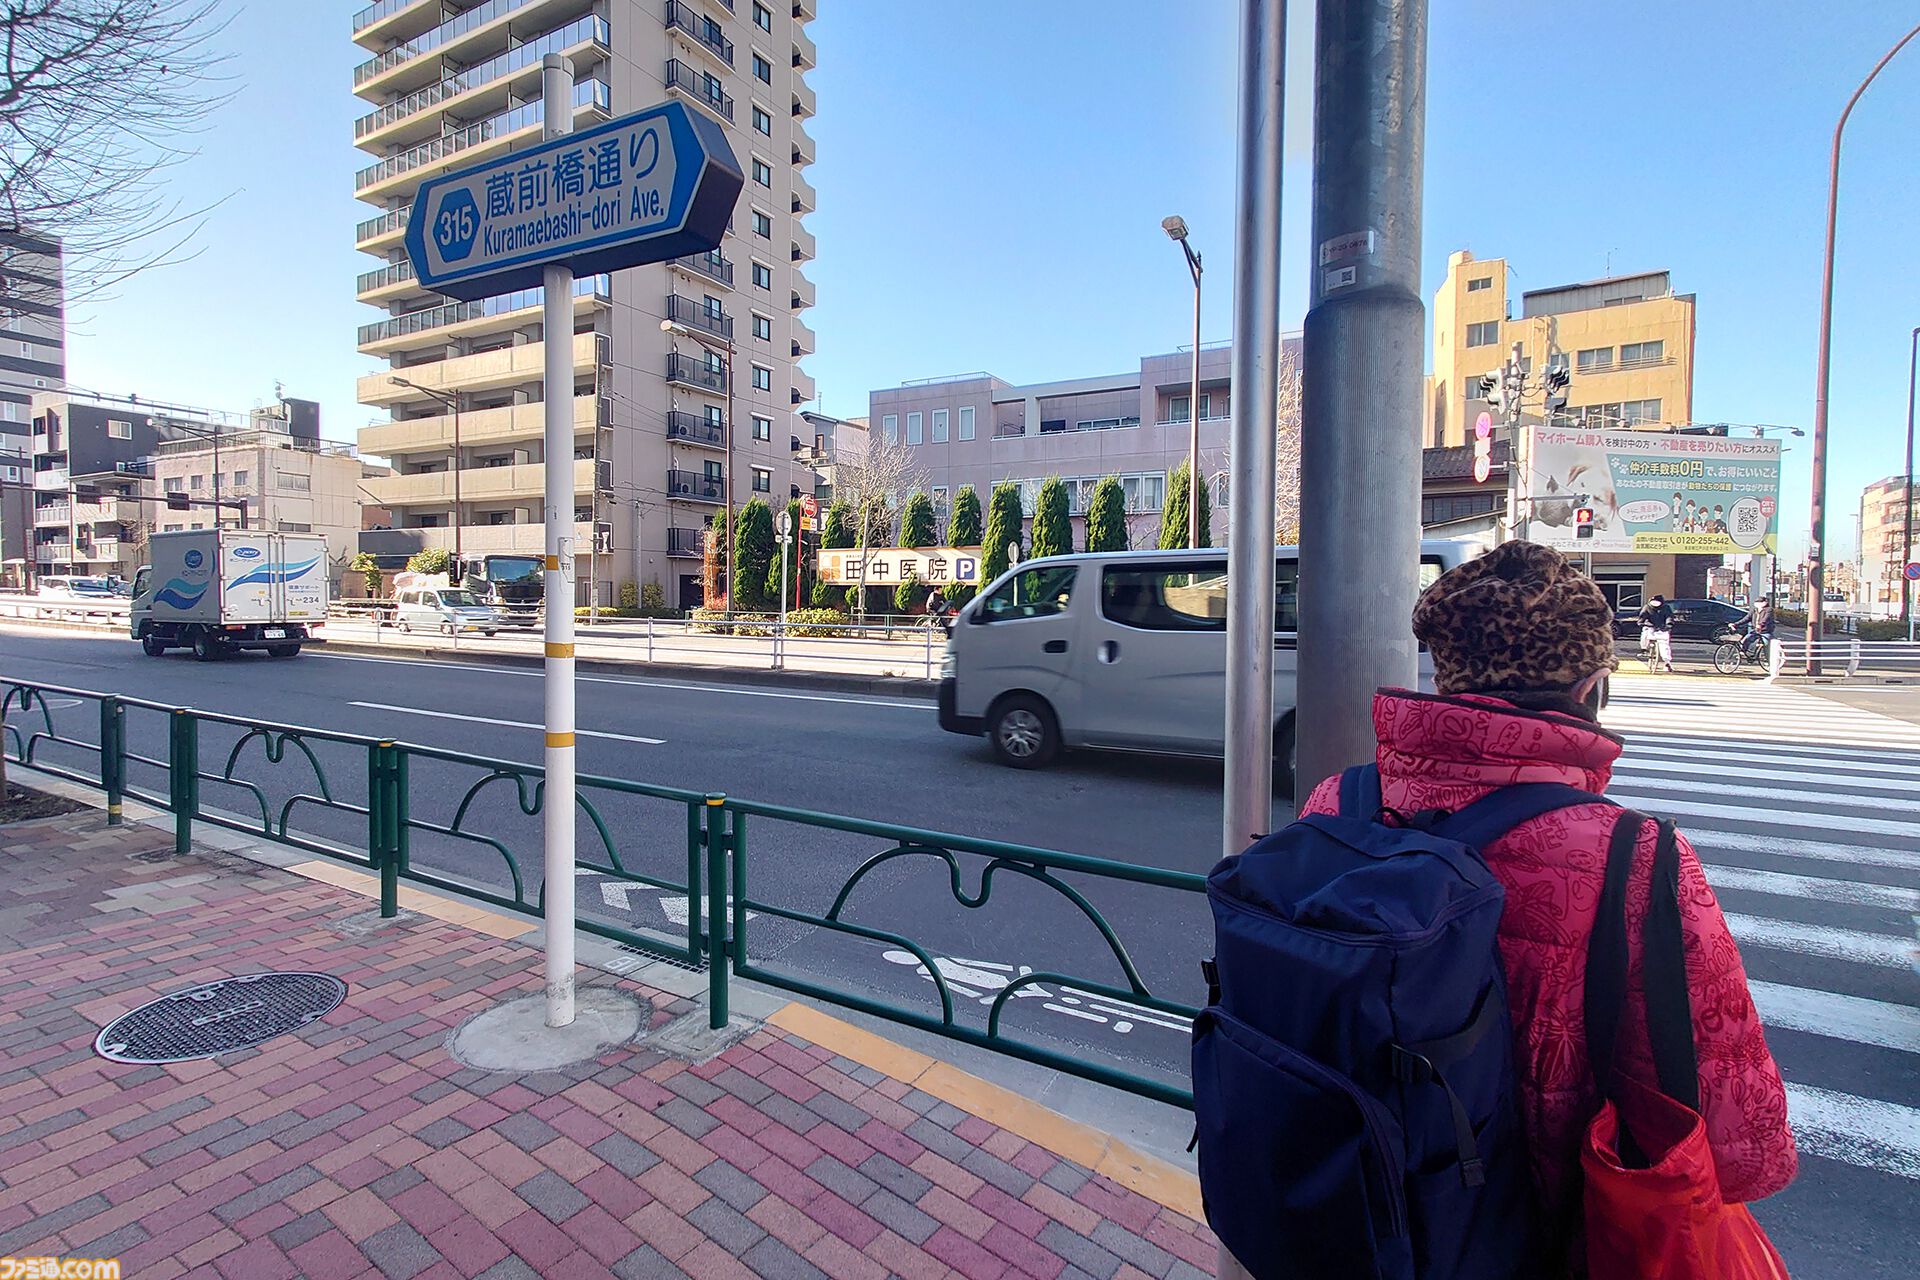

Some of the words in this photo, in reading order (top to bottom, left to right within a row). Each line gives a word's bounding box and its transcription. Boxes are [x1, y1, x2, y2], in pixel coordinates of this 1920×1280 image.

[484, 128, 660, 220] 蔵前橋通り
[439, 204, 474, 246] 315
[483, 192, 622, 257] Kuramaebashi-dori
[630, 185, 665, 221] Ave.
[1676, 536, 1729, 545] 0120-255-442
[845, 558, 948, 581] 田中医院
[303, 596, 320, 604] 234
